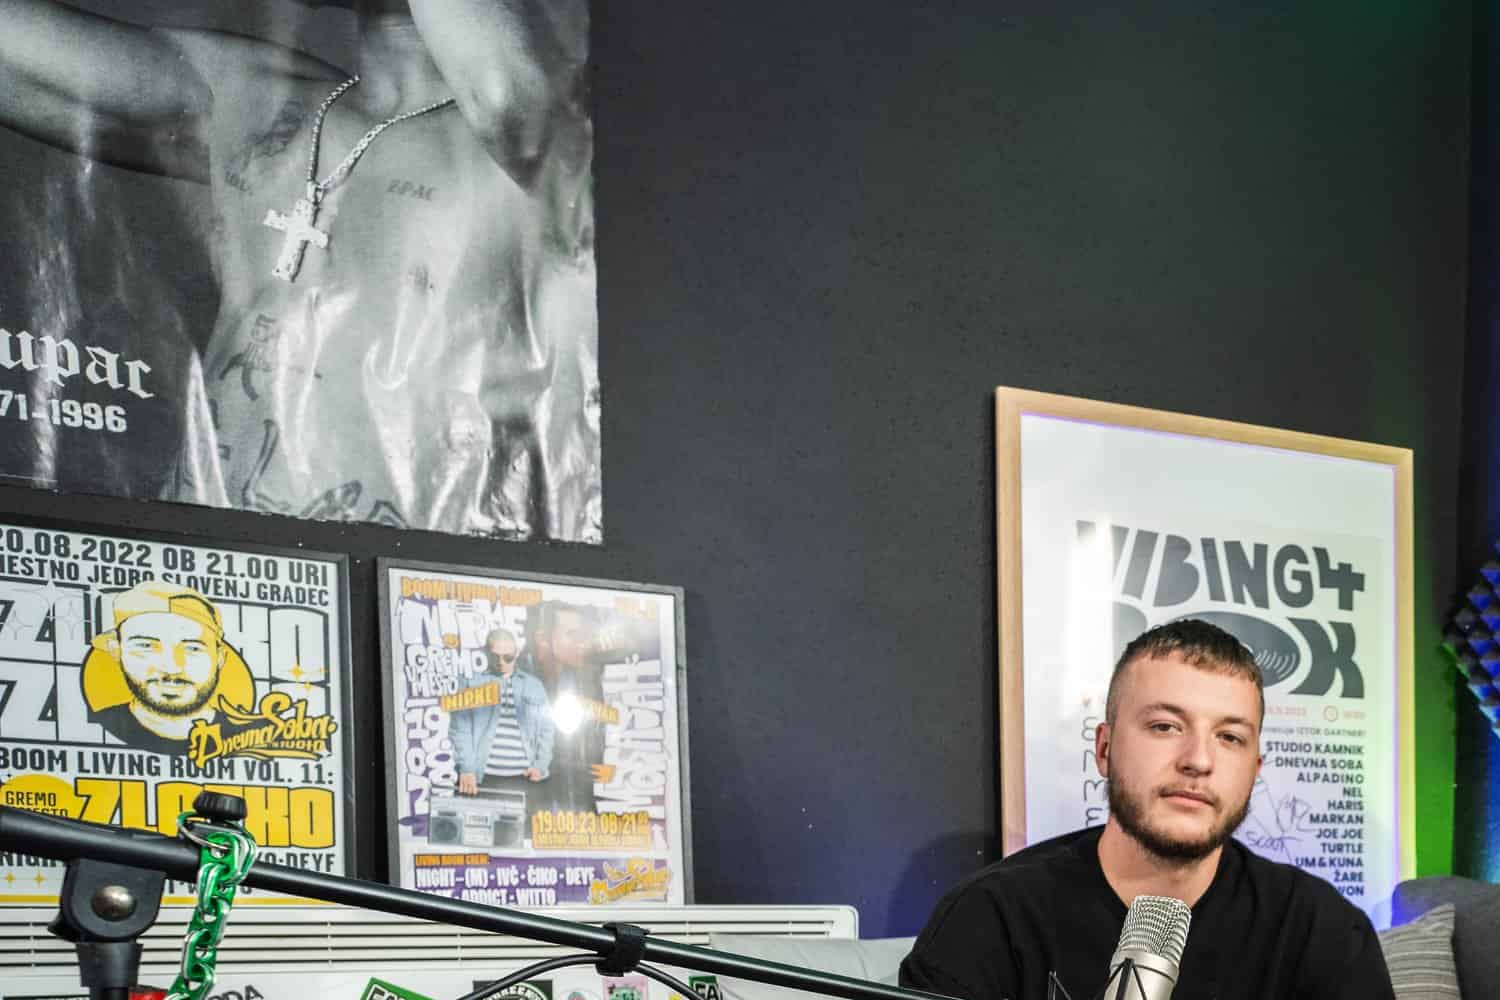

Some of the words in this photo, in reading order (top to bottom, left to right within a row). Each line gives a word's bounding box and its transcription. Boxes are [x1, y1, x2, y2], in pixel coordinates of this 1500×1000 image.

[0, 328, 155, 400] upac
[0, 389, 127, 432] 71-1996
[163, 546, 195, 572] OB
[207, 552, 279, 581] 21.00
[289, 560, 328, 587] URI
[257, 582, 329, 606] GRADEC
[1266, 741, 1312, 754] STUDIO
[1314, 743, 1364, 755] KAMNIK
[0, 748, 67, 773] BOOM
[78, 751, 161, 777] LIVING
[170, 758, 235, 781] ROOM
[244, 760, 293, 783] VOL.
[302, 763, 334, 785] 11:
[1275, 756, 1327, 768] DNEVNA
[1331, 758, 1363, 770] SOBA
[1297, 772, 1364, 784] ALPADINO
[5, 791, 57, 806] GREMO
[1342, 787, 1363, 798] NEL
[1327, 800, 1364, 811] HARIS
[1309, 813, 1363, 825] MARKAN
[1315, 828, 1338, 839] JOE
[1341, 828, 1363, 839] JOE
[1321, 842, 1363, 854] TURTLE
[1328, 857, 1363, 868] KUNA
[1333, 869, 1363, 882] ŽARE
